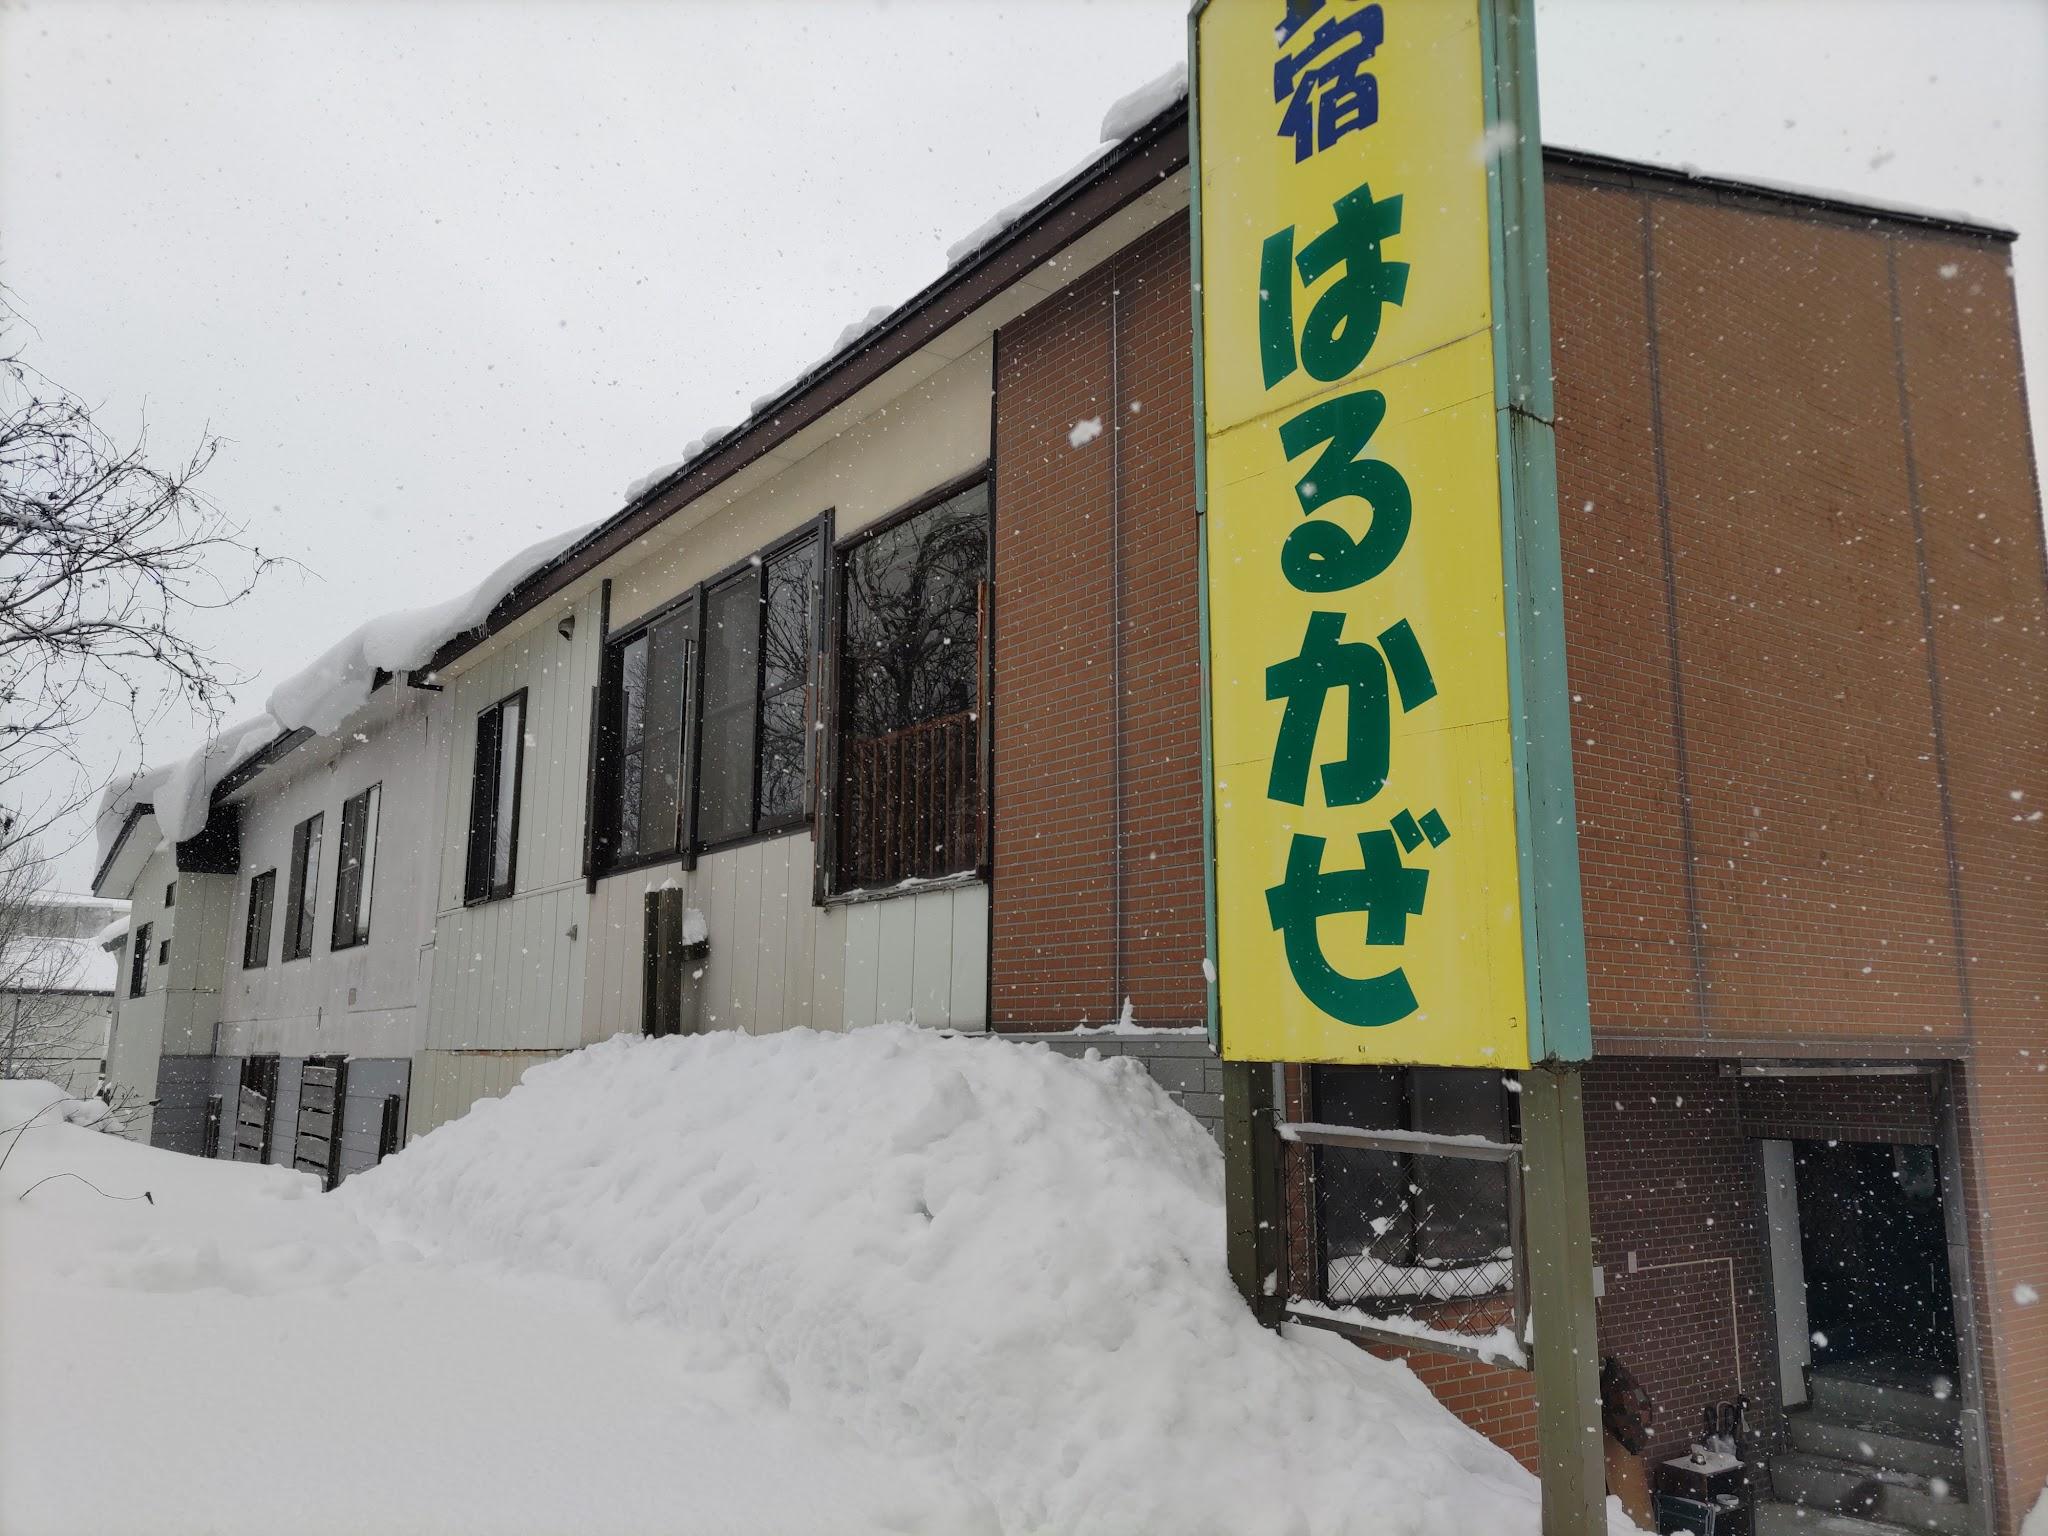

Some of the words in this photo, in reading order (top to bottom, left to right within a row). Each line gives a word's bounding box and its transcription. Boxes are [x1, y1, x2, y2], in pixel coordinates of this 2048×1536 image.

[1274, 0, 1384, 164] 宿
[1259, 182, 1451, 1027] はるかぜ
